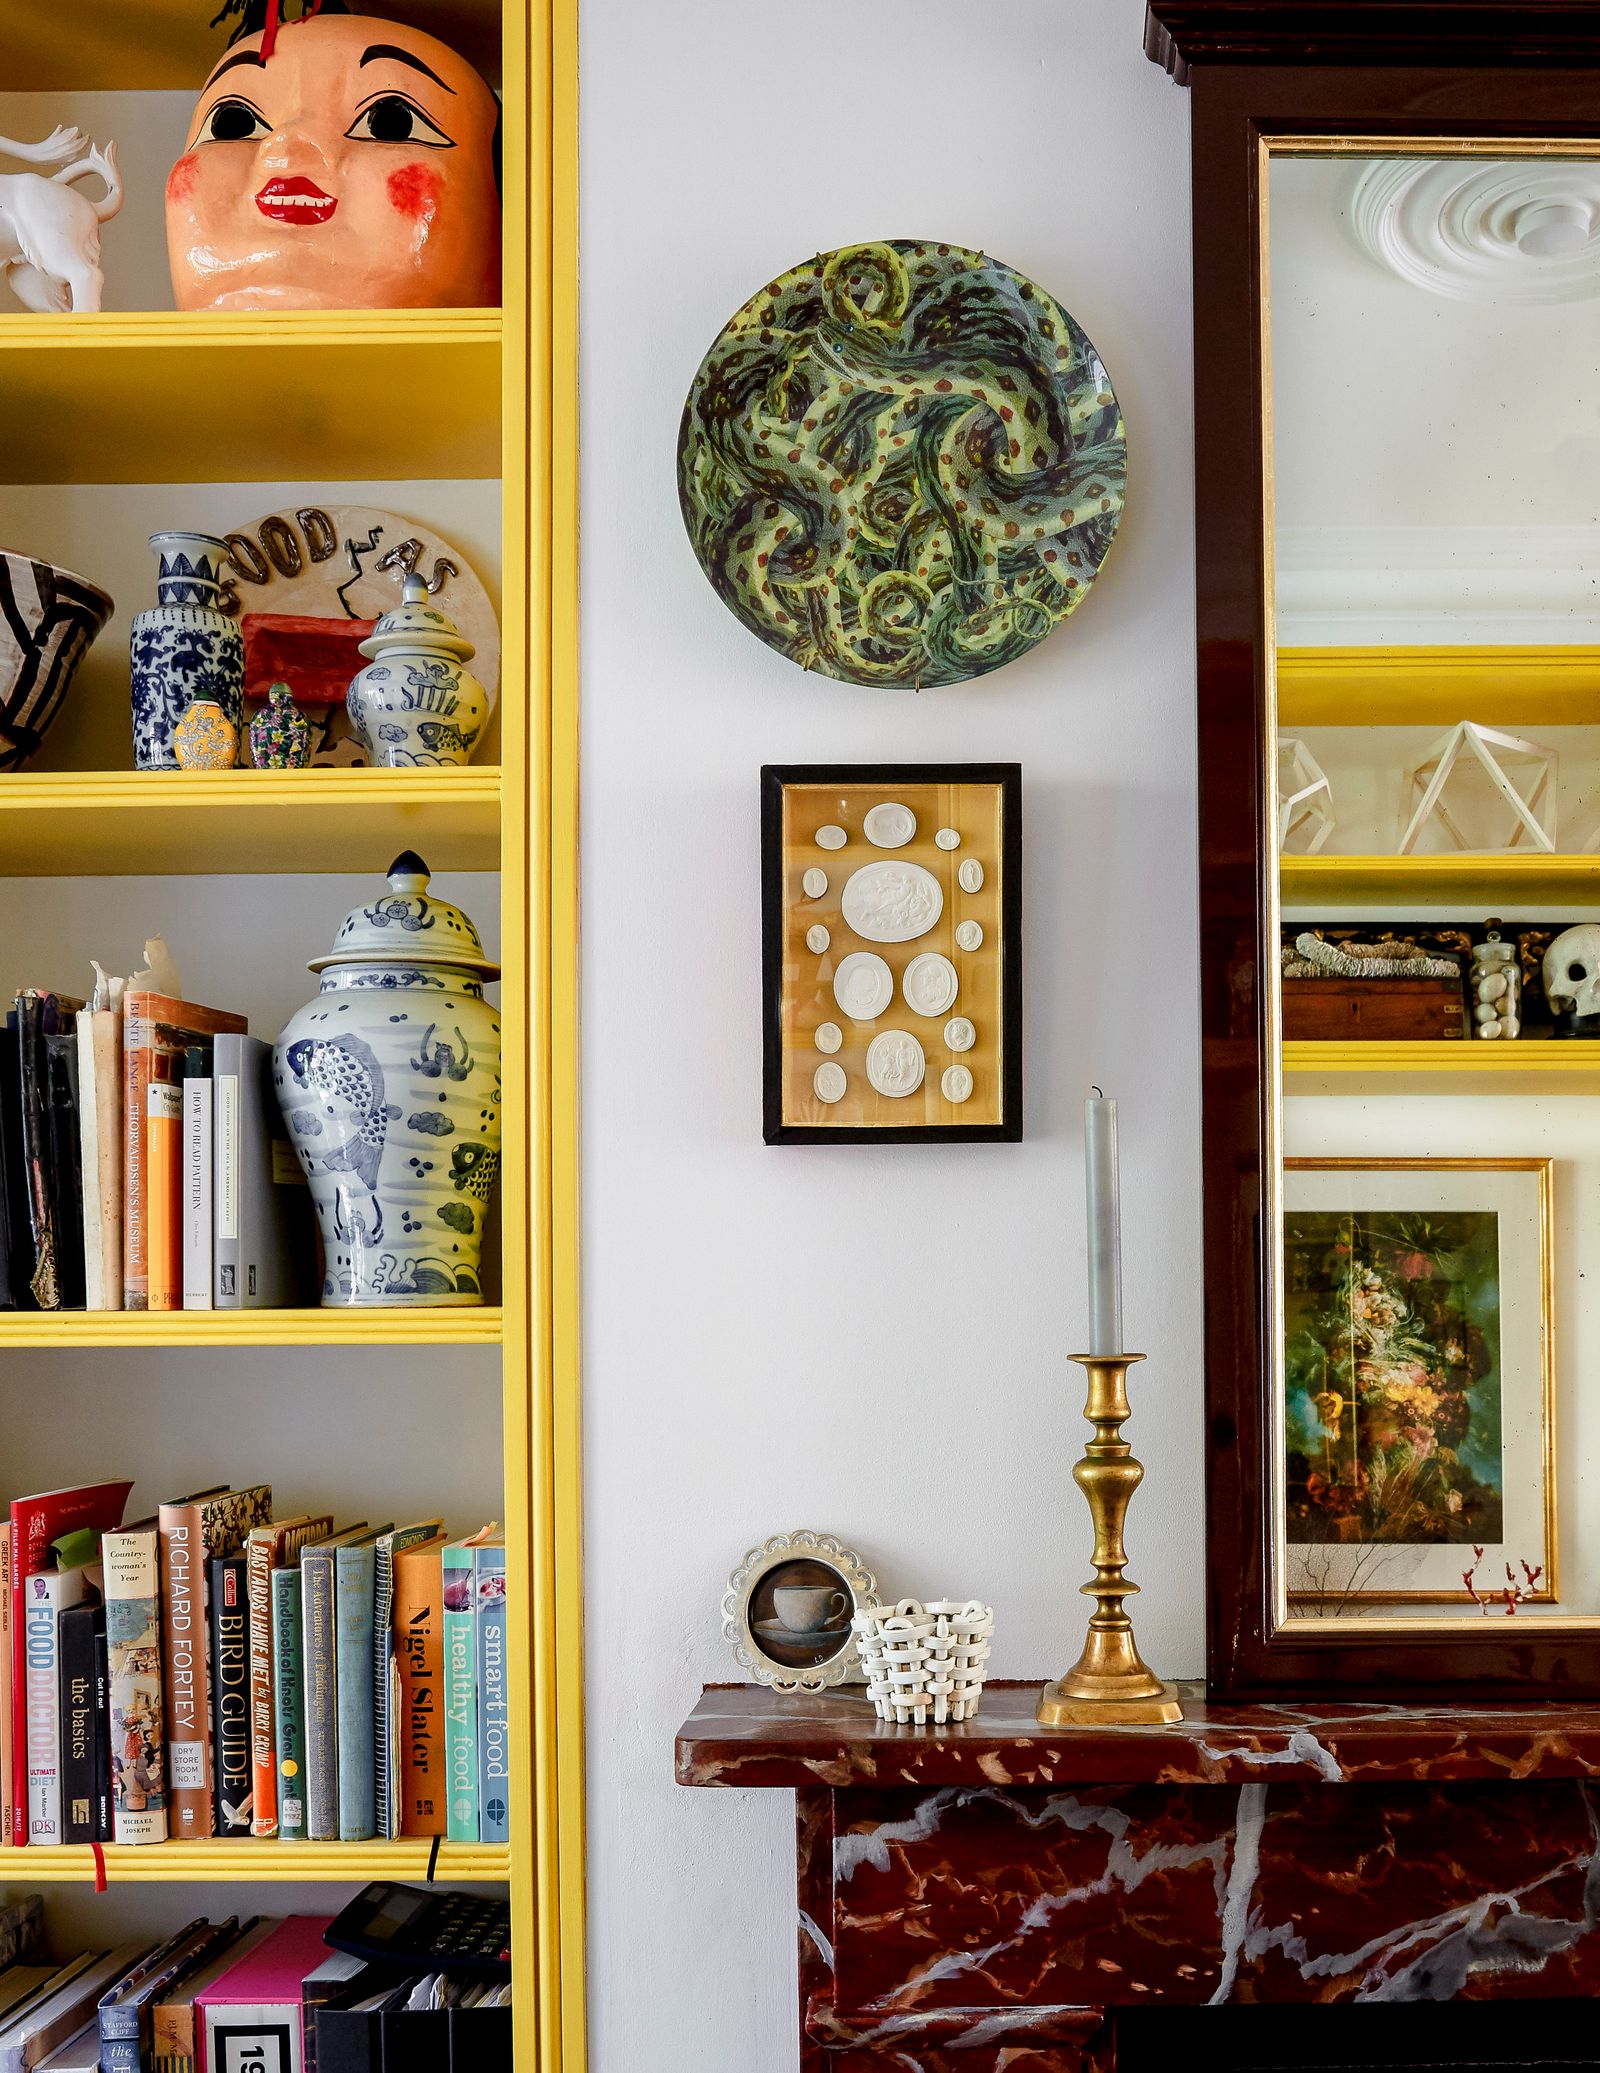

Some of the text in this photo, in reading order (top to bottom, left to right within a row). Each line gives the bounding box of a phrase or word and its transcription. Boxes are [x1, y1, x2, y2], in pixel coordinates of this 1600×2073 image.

[129, 1002, 140, 1263] BENTE LANGE THORVALDSEN'S MUSEUM
[192, 1091, 201, 1210] HOW TO READ PATTERN
[13, 1518, 17, 1527] LA
[110, 1550, 146, 1559] Country-
[120, 1538, 137, 1546] The
[111, 1561, 147, 1570] woman's
[120, 1574, 139, 1582] Year
[251, 1544, 269, 1613] BASTARDS
[312, 1568, 324, 1588] The
[225, 1576, 236, 1604] Collins
[169, 1526, 195, 1729] RICHARD FORTEY
[279, 1577, 294, 1657] Handbook
[312, 1591, 325, 1648] Adventures
[251, 1621, 269, 1654] HAVE
[403, 1604, 432, 1677] Nigel
[252, 1654, 270, 1686] MET
[281, 1657, 295, 1676] of
[315, 1650, 325, 1661] of
[28, 1607, 56, 1763] FOOD DOCTOR
[252, 1687, 271, 1699] by
[281, 1677, 297, 1718] Knots
[71, 1677, 90, 1759] the basics
[219, 1614, 247, 1790] BIRD GUIDE
[255, 1700, 270, 1735] BARRY
[448, 1624, 474, 1791] healthy food
[485, 1625, 509, 1780] smart food
[410, 1687, 433, 1774] Slater
[174, 1756, 199, 1764] STORE
[178, 1747, 193, 1755] DRY
[255, 1734, 270, 1768] CRUMP
[282, 1723, 298, 1800] Grauont
[30, 1768, 56, 1776] ULTIMATE
[30, 1776, 56, 1786] DIET
[103, 2021, 138, 2029] STAFFORD
[110, 2028, 130, 2036] CLIFF
[111, 2044, 132, 2057] the
